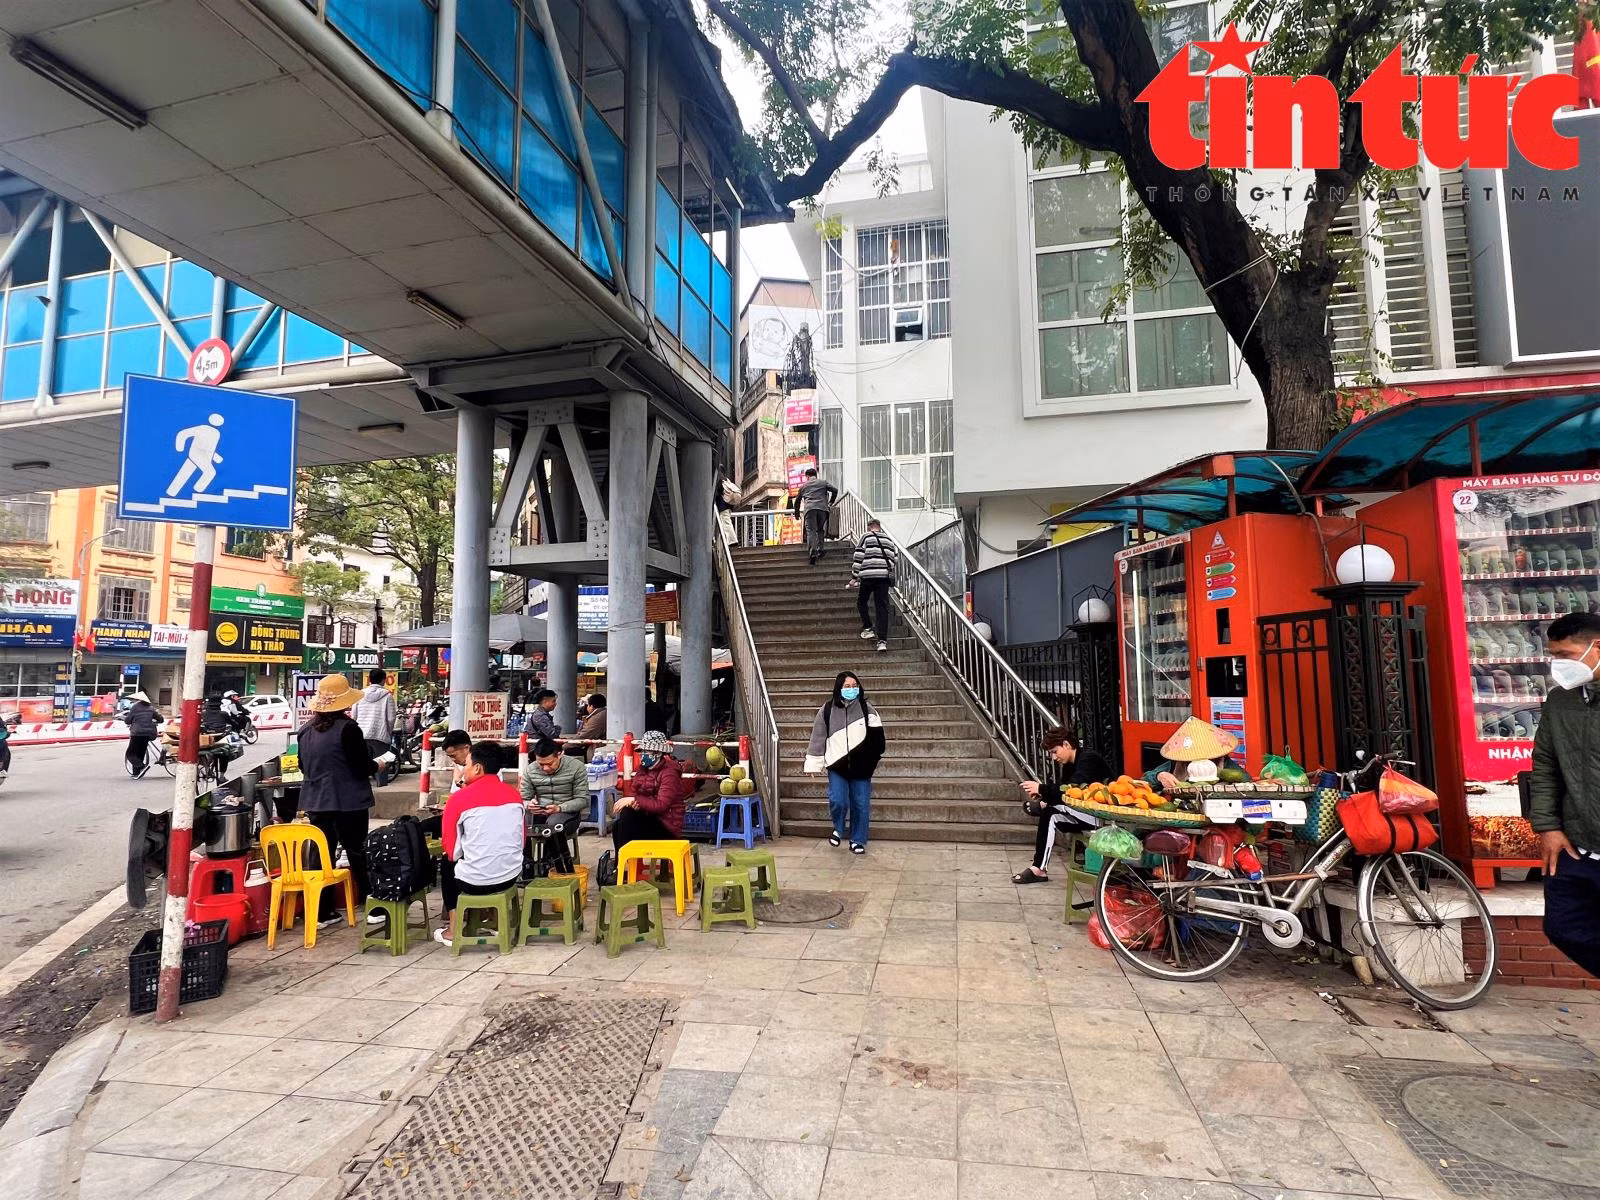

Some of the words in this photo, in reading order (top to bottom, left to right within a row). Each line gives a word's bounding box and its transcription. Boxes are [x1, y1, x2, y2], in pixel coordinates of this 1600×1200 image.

[1462, 477, 1489, 488] MÁY
[1492, 476, 1519, 487] BÁN
[1522, 474, 1559, 485] HÀNG
[1459, 495, 1472, 505] 22
[250, 639, 263, 653] HẠ
[344, 653, 356, 664] LA
[473, 700, 486, 713] CHO
[1488, 745, 1534, 761] NHẬN
